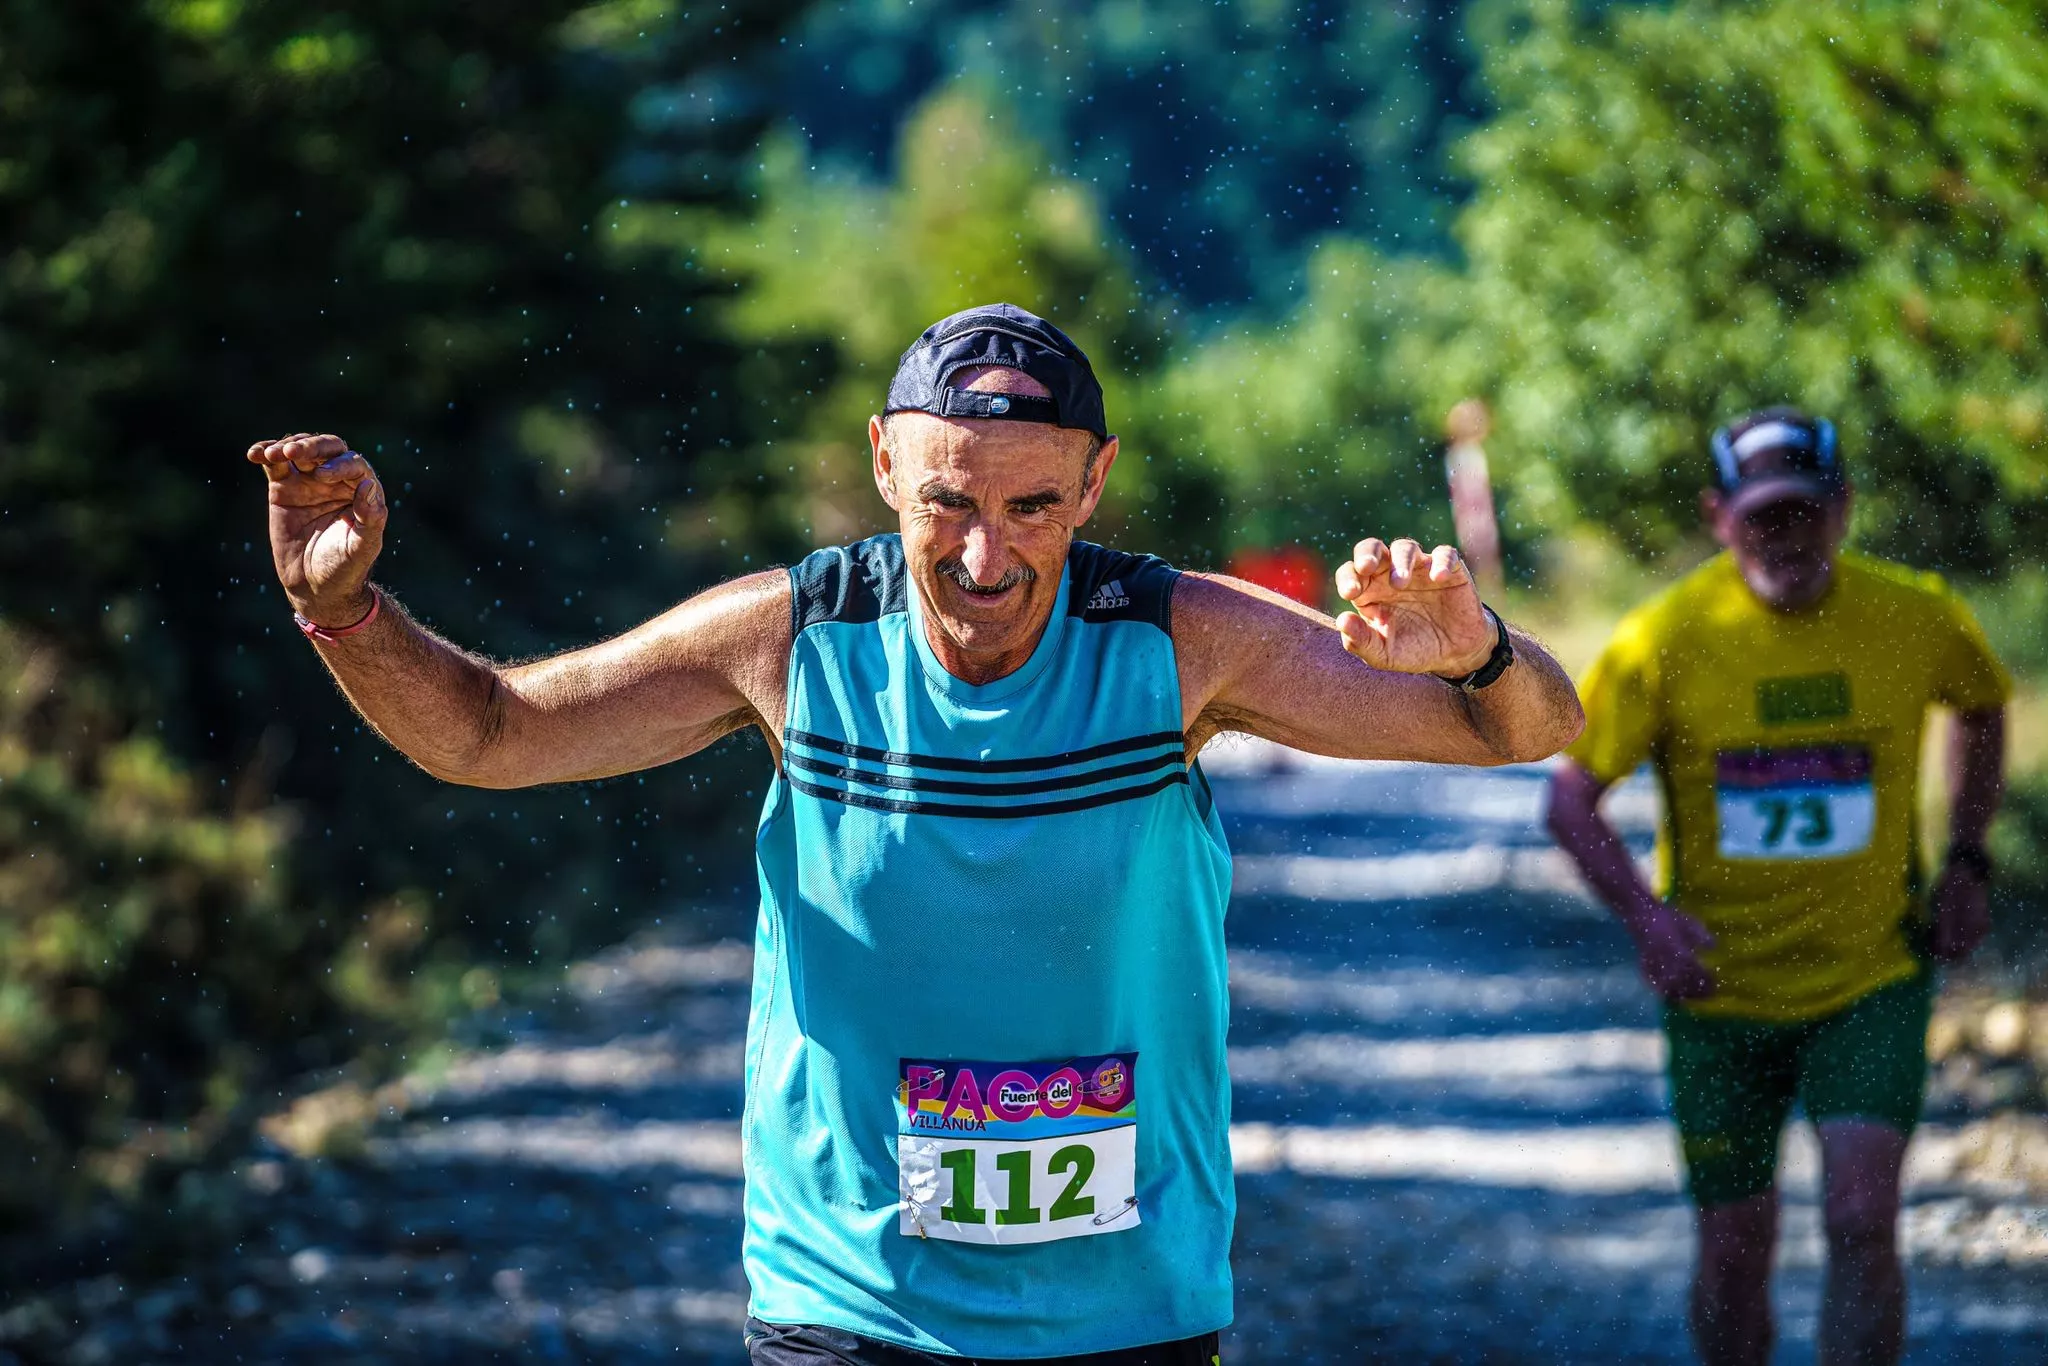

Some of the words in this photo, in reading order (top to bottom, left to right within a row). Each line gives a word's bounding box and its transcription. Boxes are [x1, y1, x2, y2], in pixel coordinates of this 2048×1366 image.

[1087, 595, 1130, 609] adidas
[1755, 798, 1834, 848] 73
[907, 1065, 1083, 1123] PACO
[1000, 1088, 1048, 1104] Fuente
[1050, 1083, 1073, 1099] del
[909, 1113, 987, 1132] VILLANÚA
[940, 1144, 1096, 1226] 112
